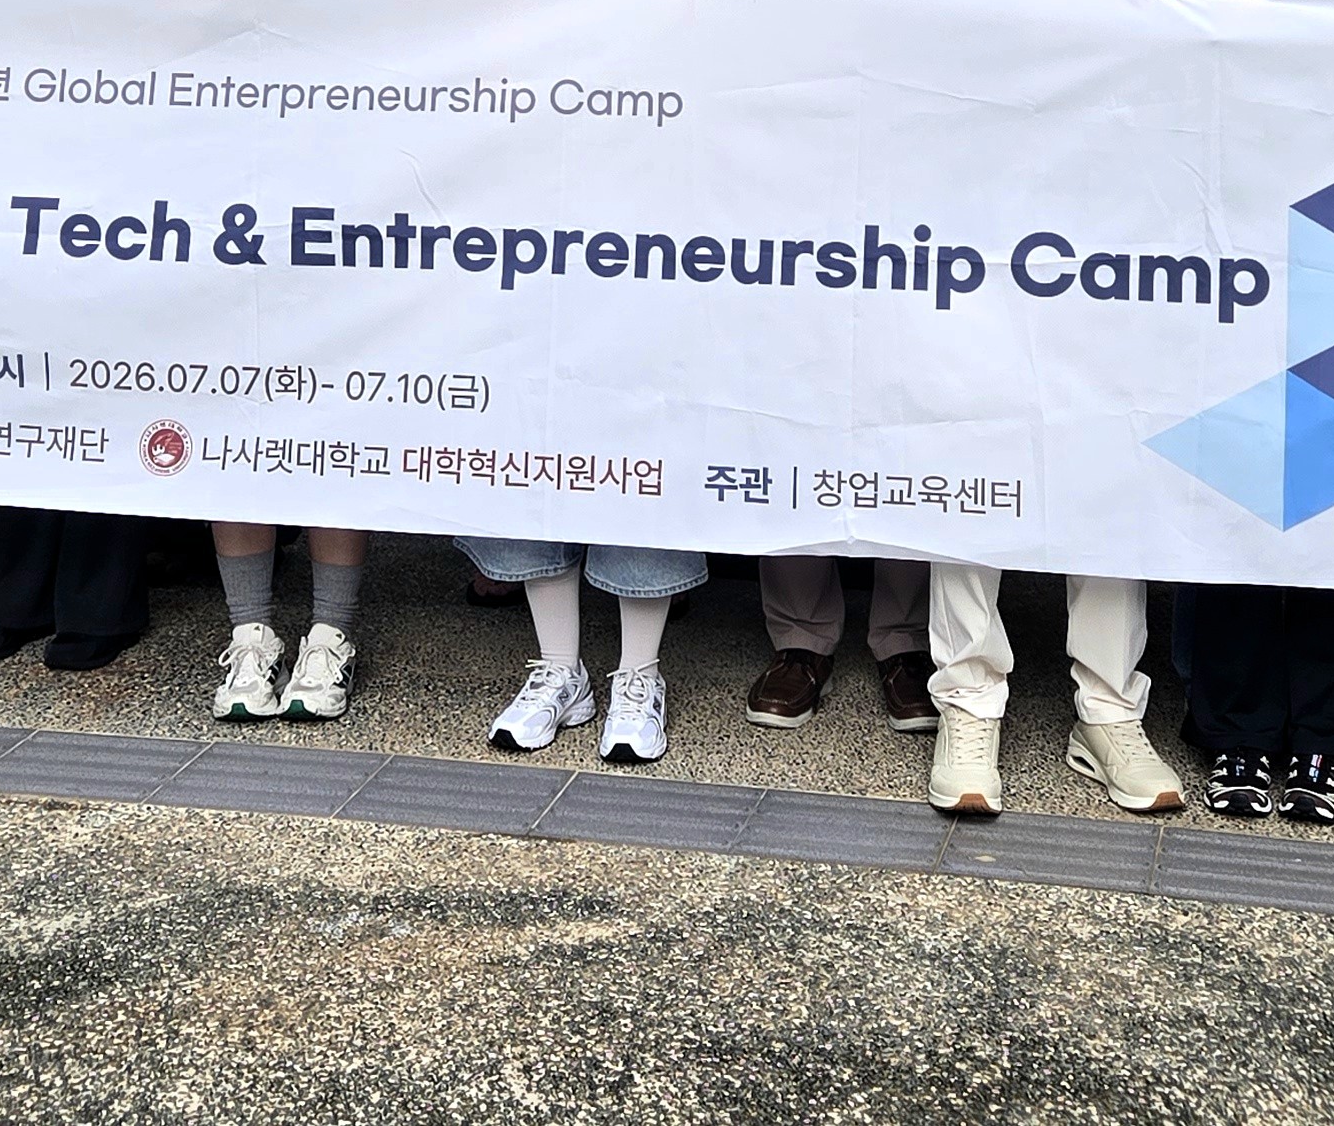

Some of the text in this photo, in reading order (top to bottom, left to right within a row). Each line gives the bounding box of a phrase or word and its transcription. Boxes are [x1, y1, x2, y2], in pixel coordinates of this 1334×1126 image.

[24, 68, 157, 108] Global
[169, 72, 537, 123] Enterpreneurship
[550, 78, 684, 126] Camp
[10, 195, 192, 262] Tech
[213, 204, 266, 266] &
[290, 207, 986, 311] Entrepreneurship
[1010, 231, 1271, 324] Camp
[345, 370, 491, 413] 07.10(금)
[201, 435, 390, 477] 나사렛대학교
[402, 445, 664, 497] 대학혁신지원사업
[704, 464, 773, 505] 주관
[811, 470, 1023, 517] 창업교육센터
